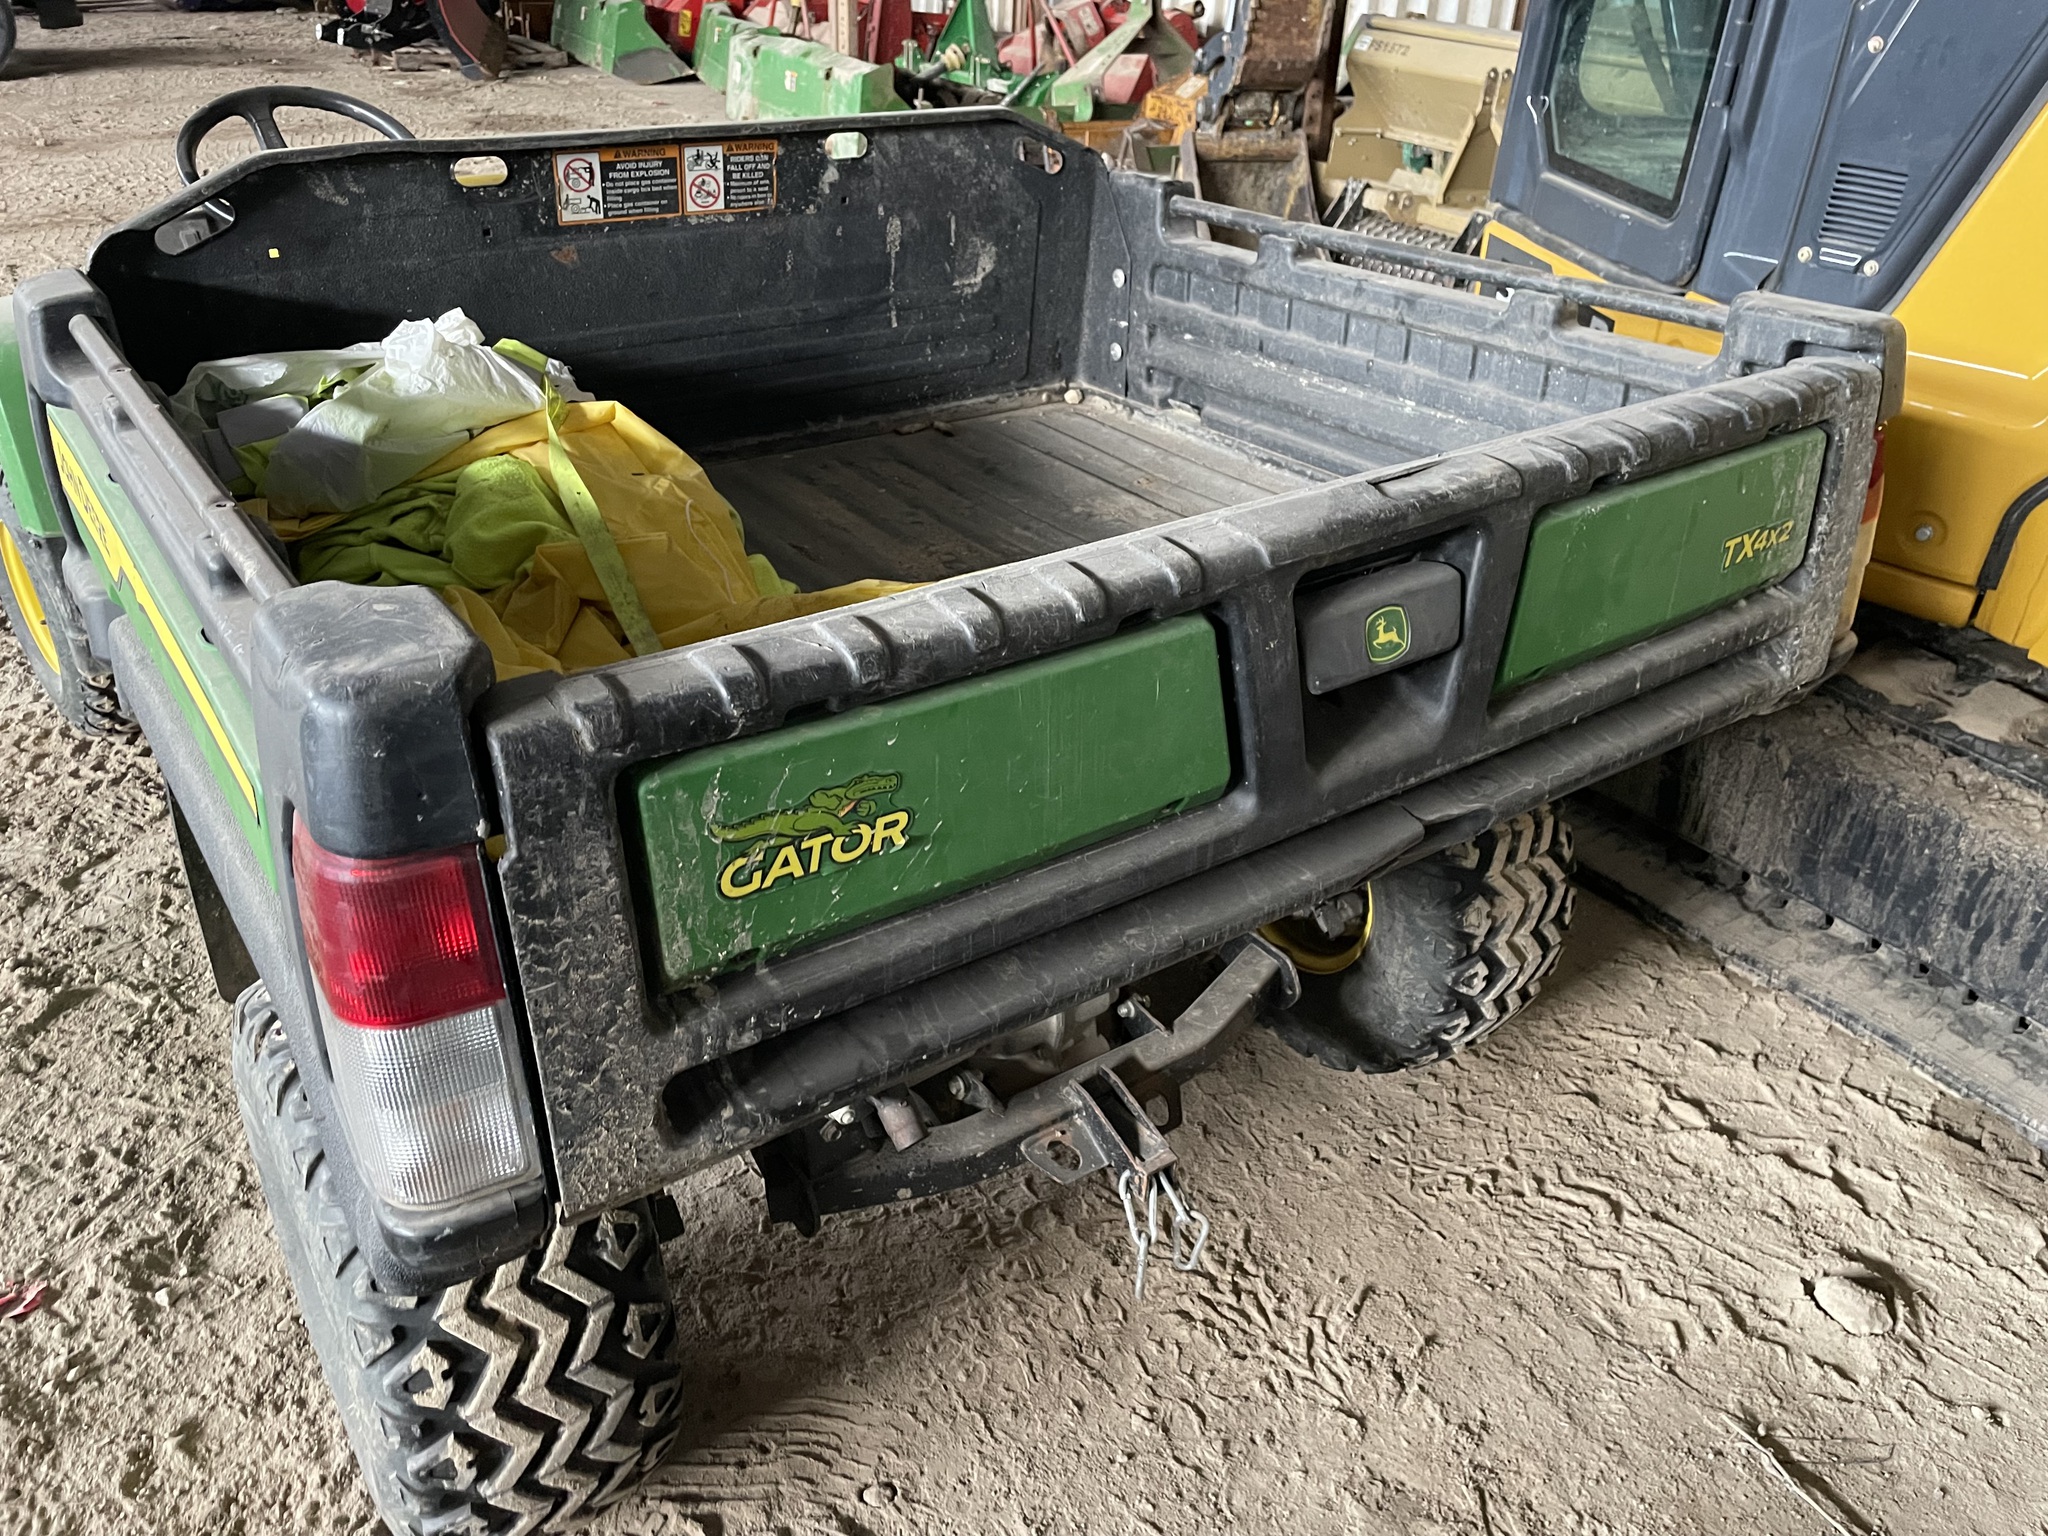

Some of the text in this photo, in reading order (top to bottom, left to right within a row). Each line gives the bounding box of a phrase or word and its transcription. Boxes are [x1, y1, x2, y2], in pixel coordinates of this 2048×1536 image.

[735, 143, 775, 151] WARNING
[622, 148, 666, 158] WARNING
[638, 160, 662, 168] INJURY
[609, 169, 670, 179] FROM EXPLOSION
[719, 810, 911, 899] GATOR
